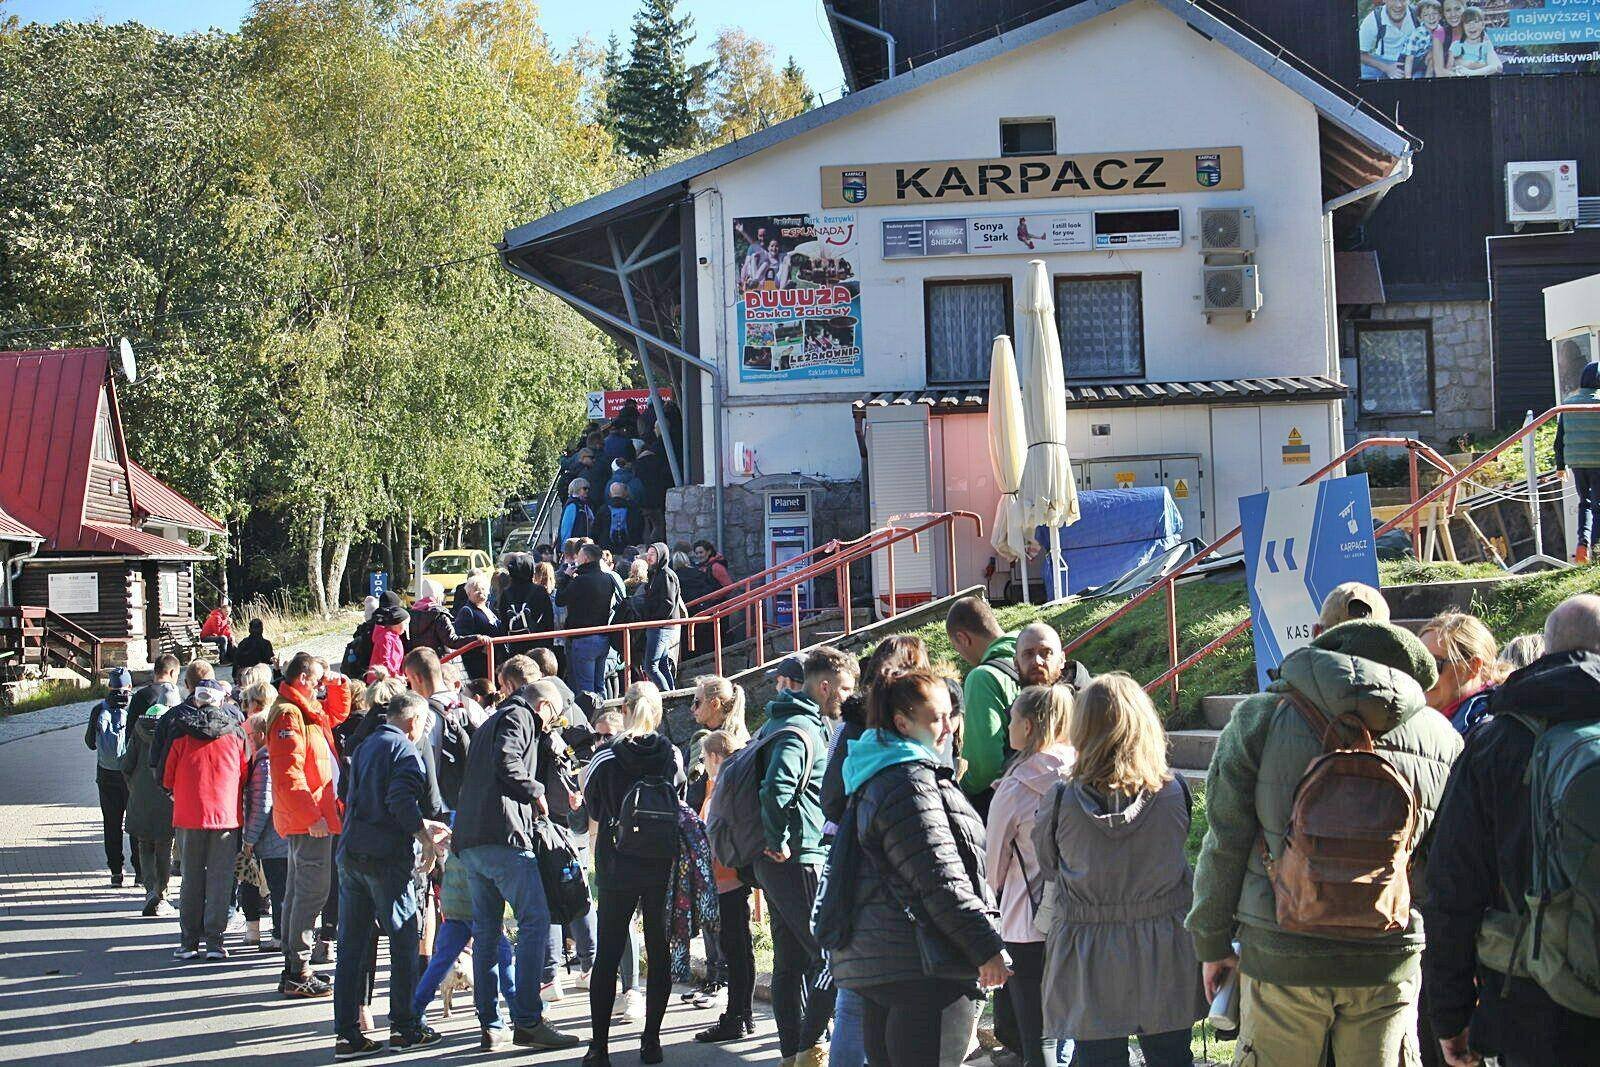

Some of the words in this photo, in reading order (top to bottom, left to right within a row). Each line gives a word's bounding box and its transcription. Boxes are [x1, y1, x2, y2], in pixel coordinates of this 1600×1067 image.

[1516, 10, 1590, 25] najwyższej
[1493, 28, 1566, 42] widokowej
[1570, 30, 1581, 39] w
[896, 157, 1166, 199] KARPACZ
[973, 222, 1004, 232] Sonya
[1068, 221, 1082, 229] look
[781, 226, 845, 238] ESPLANADA
[983, 232, 1009, 242] Stark
[745, 285, 851, 308] DUUUŻA
[746, 308, 791, 319] Dawka
[794, 306, 851, 318] Zabawy
[775, 498, 800, 507] Planet
[1340, 540, 1367, 552] KARPACZ
[1286, 624, 1314, 640] KAS
